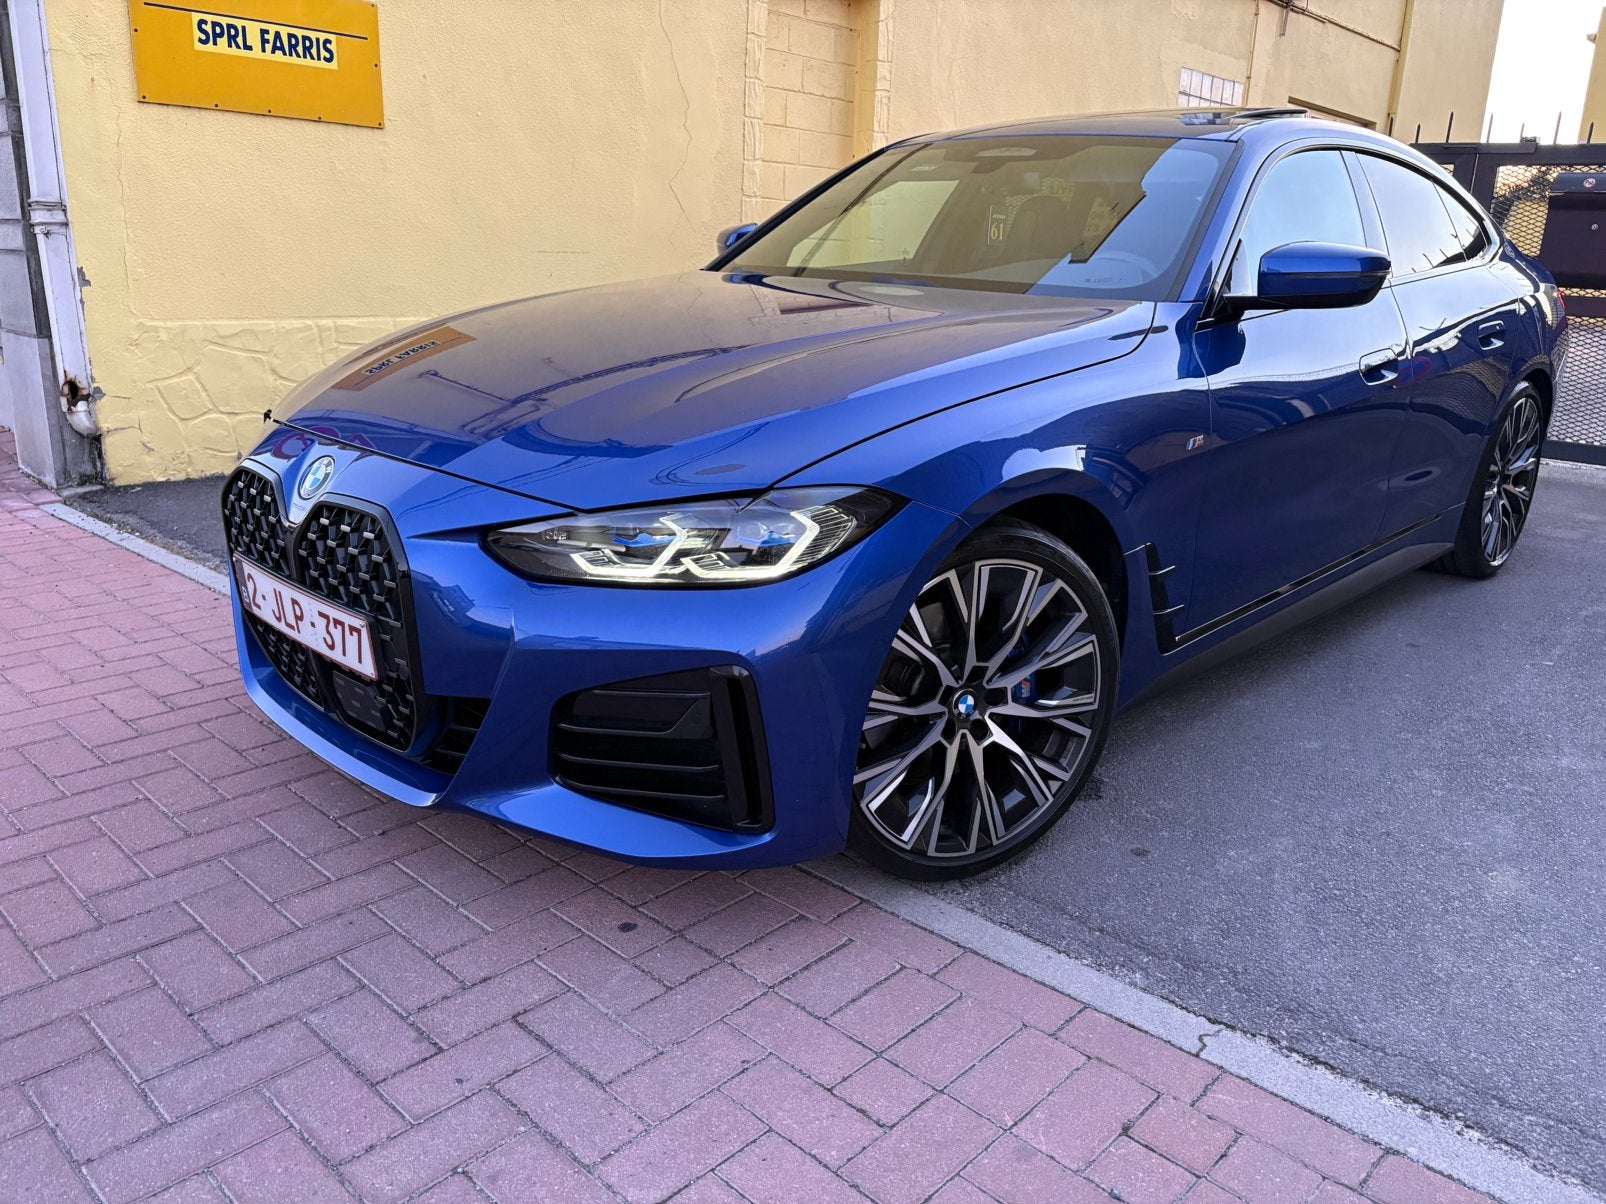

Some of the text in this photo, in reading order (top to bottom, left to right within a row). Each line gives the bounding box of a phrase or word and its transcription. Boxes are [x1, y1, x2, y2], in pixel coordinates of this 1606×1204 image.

[197, 18, 334, 63] SPRL FARRIS
[990, 222, 1004, 241] 61
[241, 585, 250, 603] B
